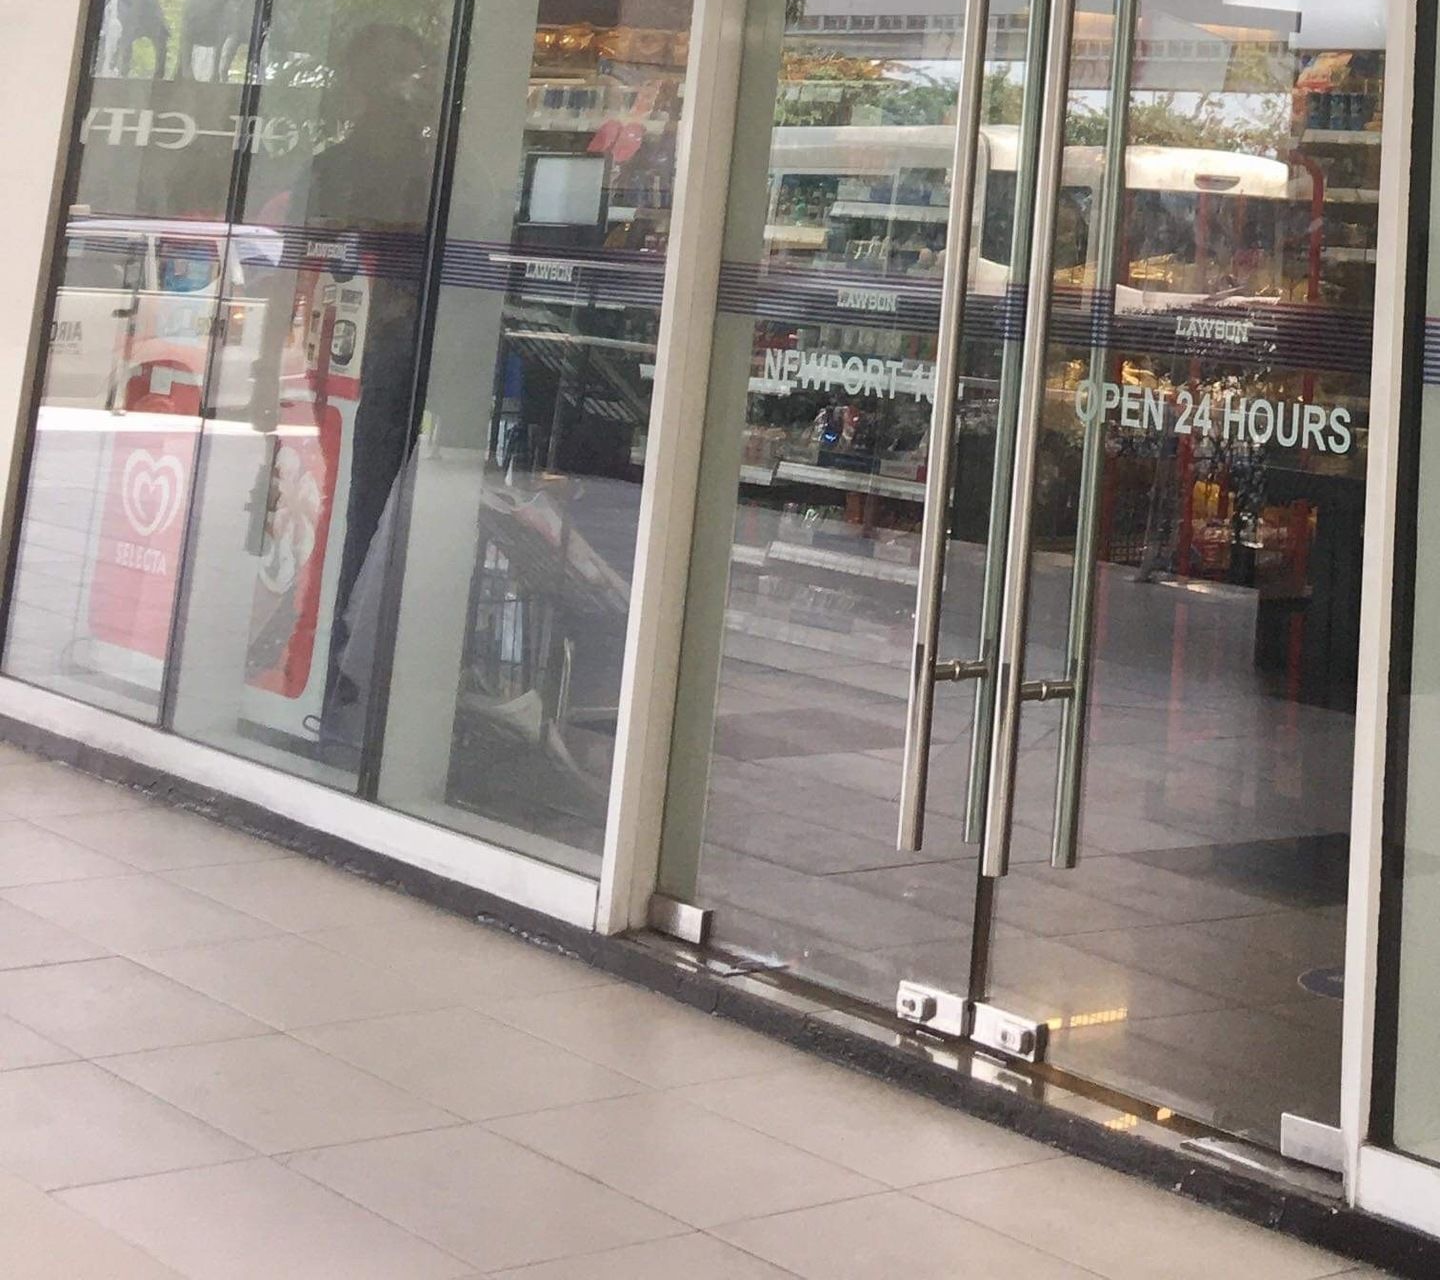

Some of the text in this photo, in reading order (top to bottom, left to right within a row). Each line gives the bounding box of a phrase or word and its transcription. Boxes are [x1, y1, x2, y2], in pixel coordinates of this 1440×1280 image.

[837, 289, 897, 313] LAWSON
[1175, 316, 1252, 343] LAWSON
[763, 347, 904, 400] NEWPORT
[1075, 379, 1352, 455] OPEN 24 HOURS
[115, 541, 168, 576] SELECTA
